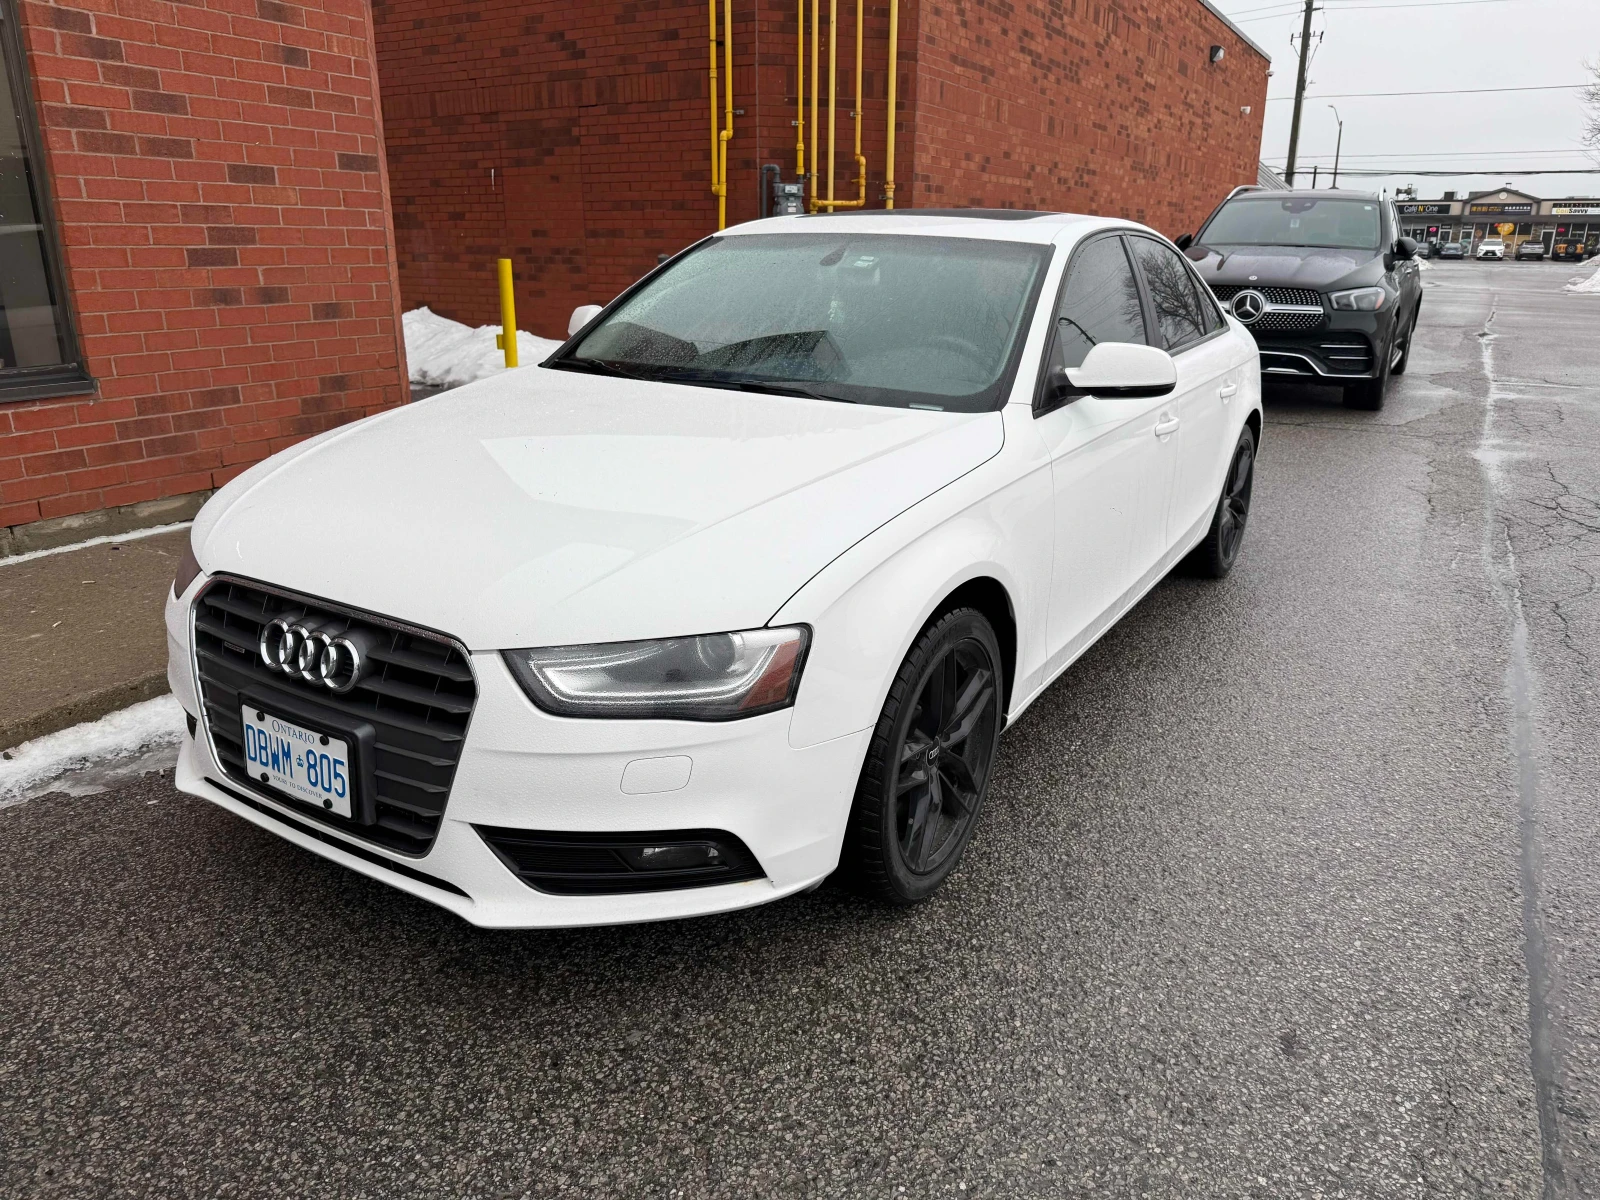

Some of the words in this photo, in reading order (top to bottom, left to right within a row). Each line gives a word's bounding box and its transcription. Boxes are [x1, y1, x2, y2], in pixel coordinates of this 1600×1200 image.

[1404, 205, 1417, 213] Café
[272, 720, 315, 745] ONTARIO
[245, 723, 293, 779] DBWM
[305, 748, 346, 798] 805
[289, 781, 296, 789] TO
[296, 784, 323, 800] DISCOVER
